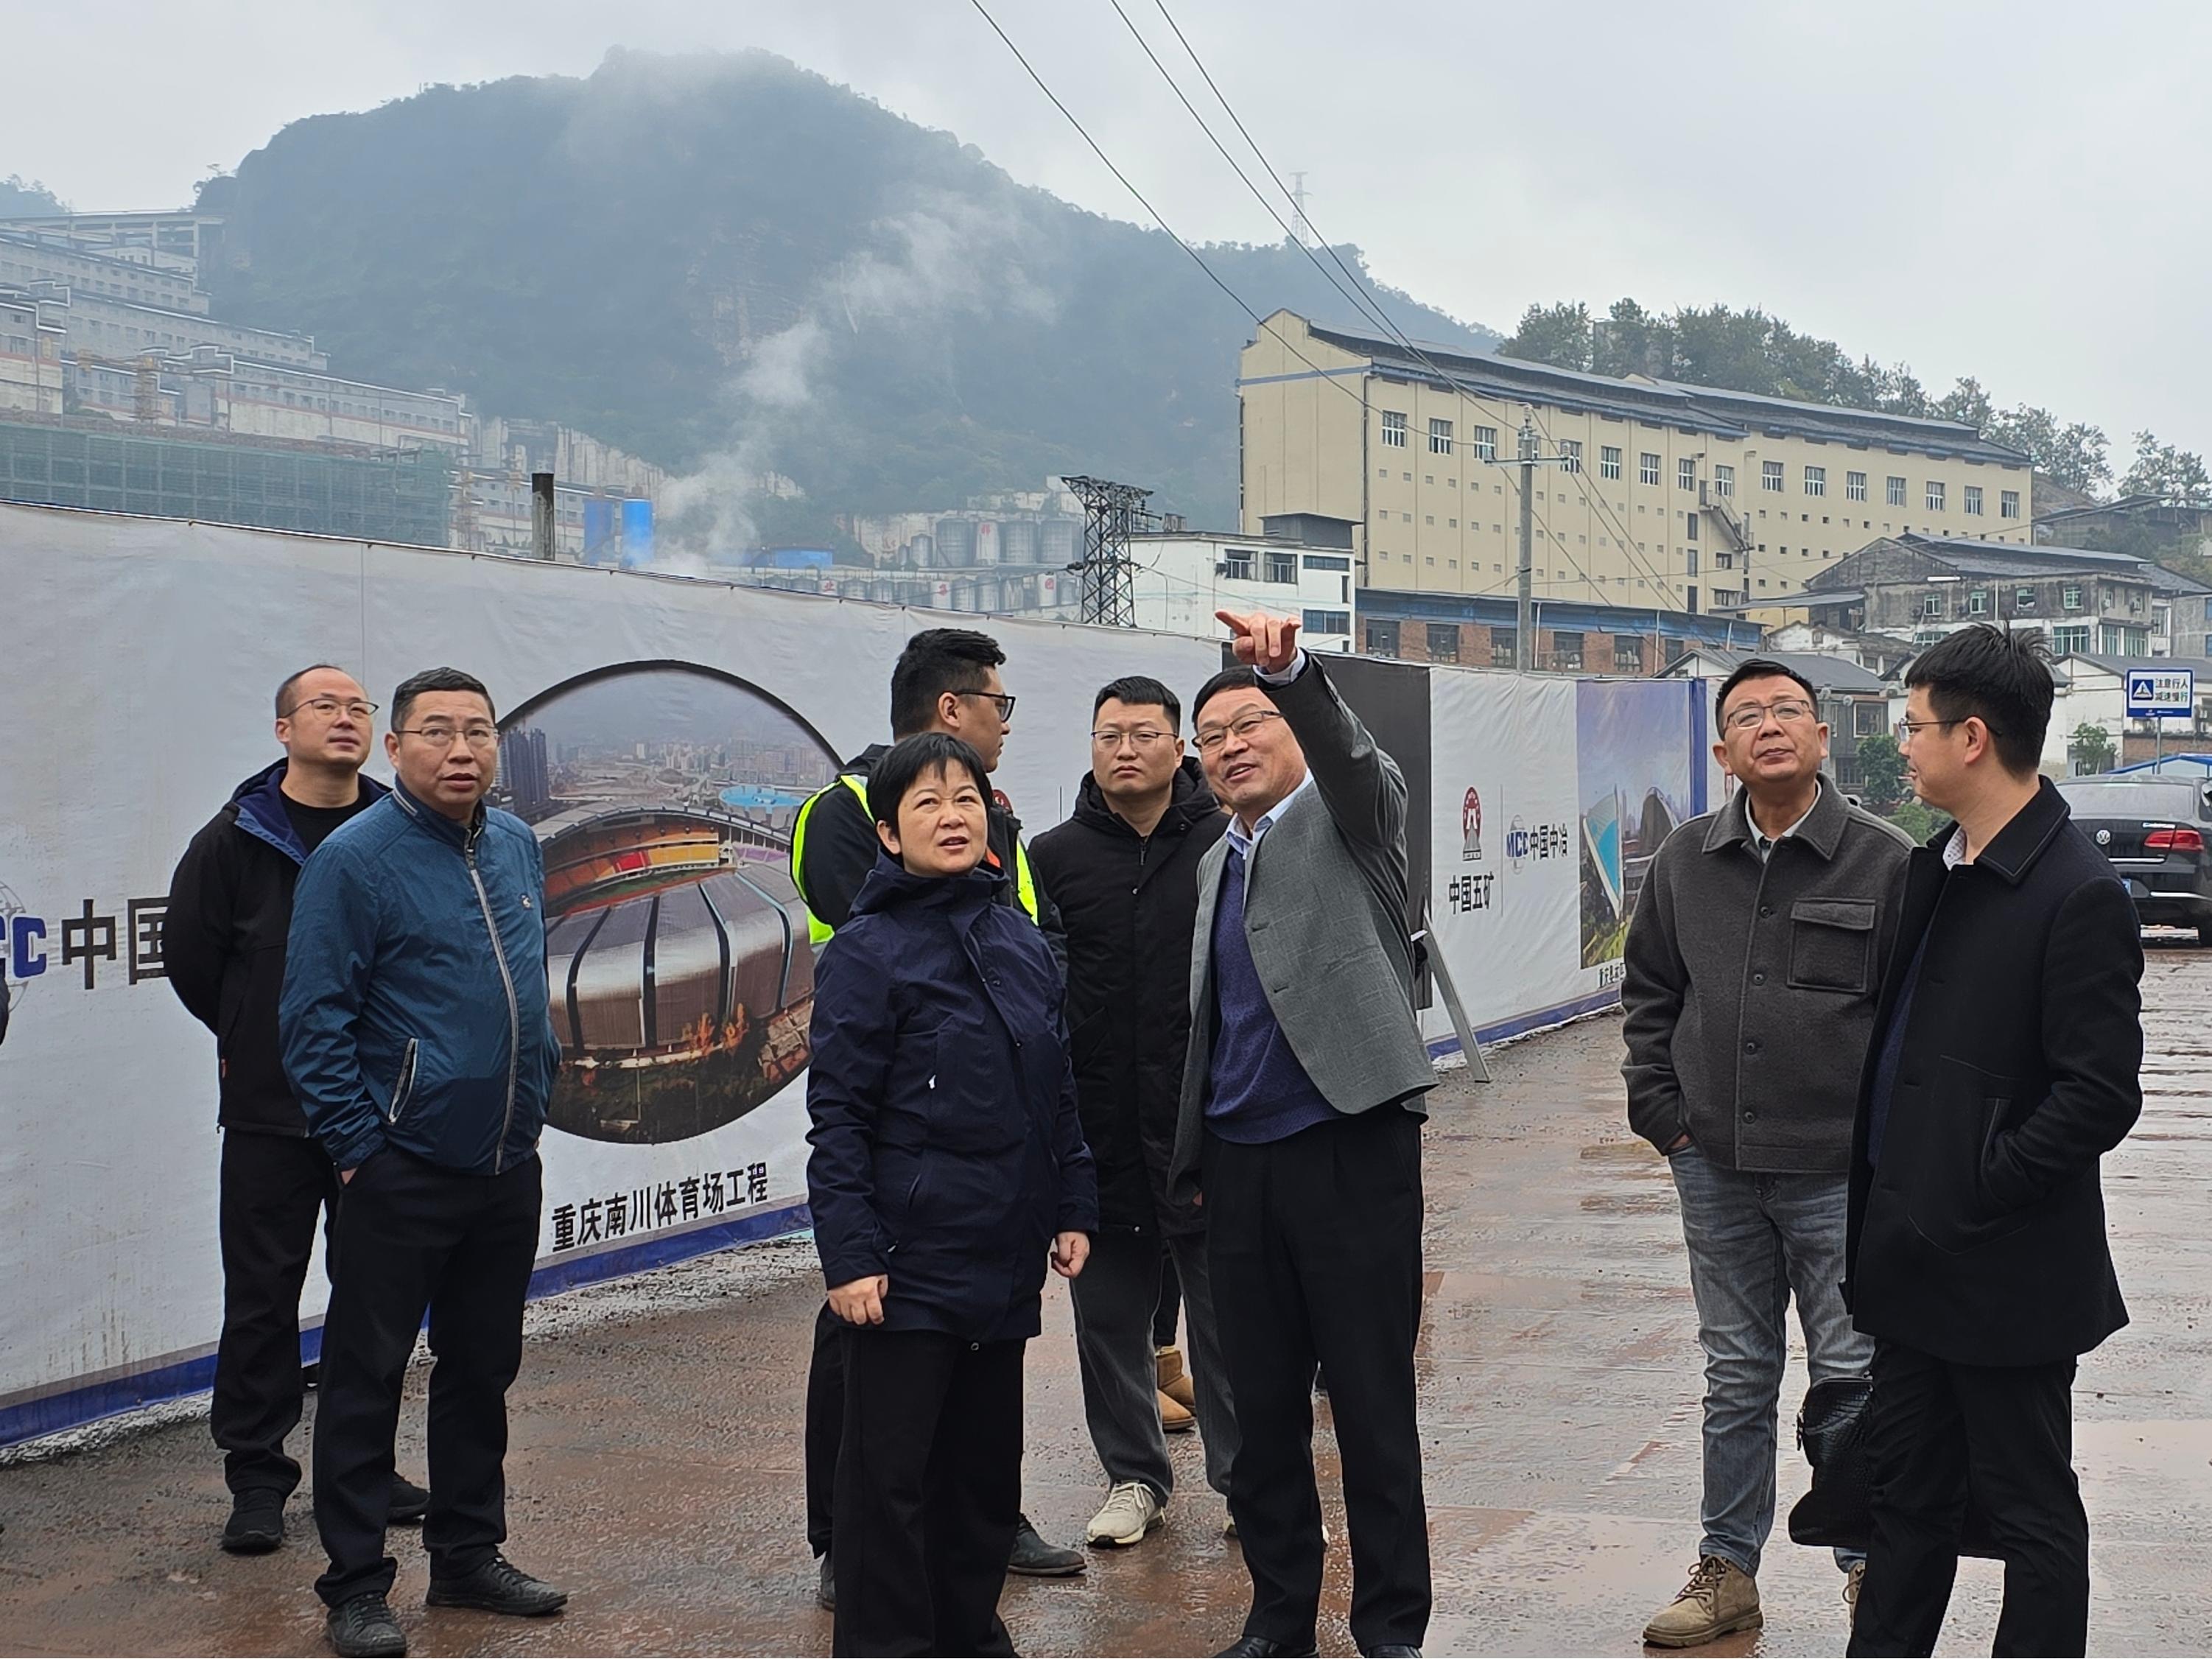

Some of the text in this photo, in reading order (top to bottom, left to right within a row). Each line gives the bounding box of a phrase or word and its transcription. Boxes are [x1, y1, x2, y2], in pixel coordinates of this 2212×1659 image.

[551, 1162, 768, 1252] 重庆南川体育场工程
